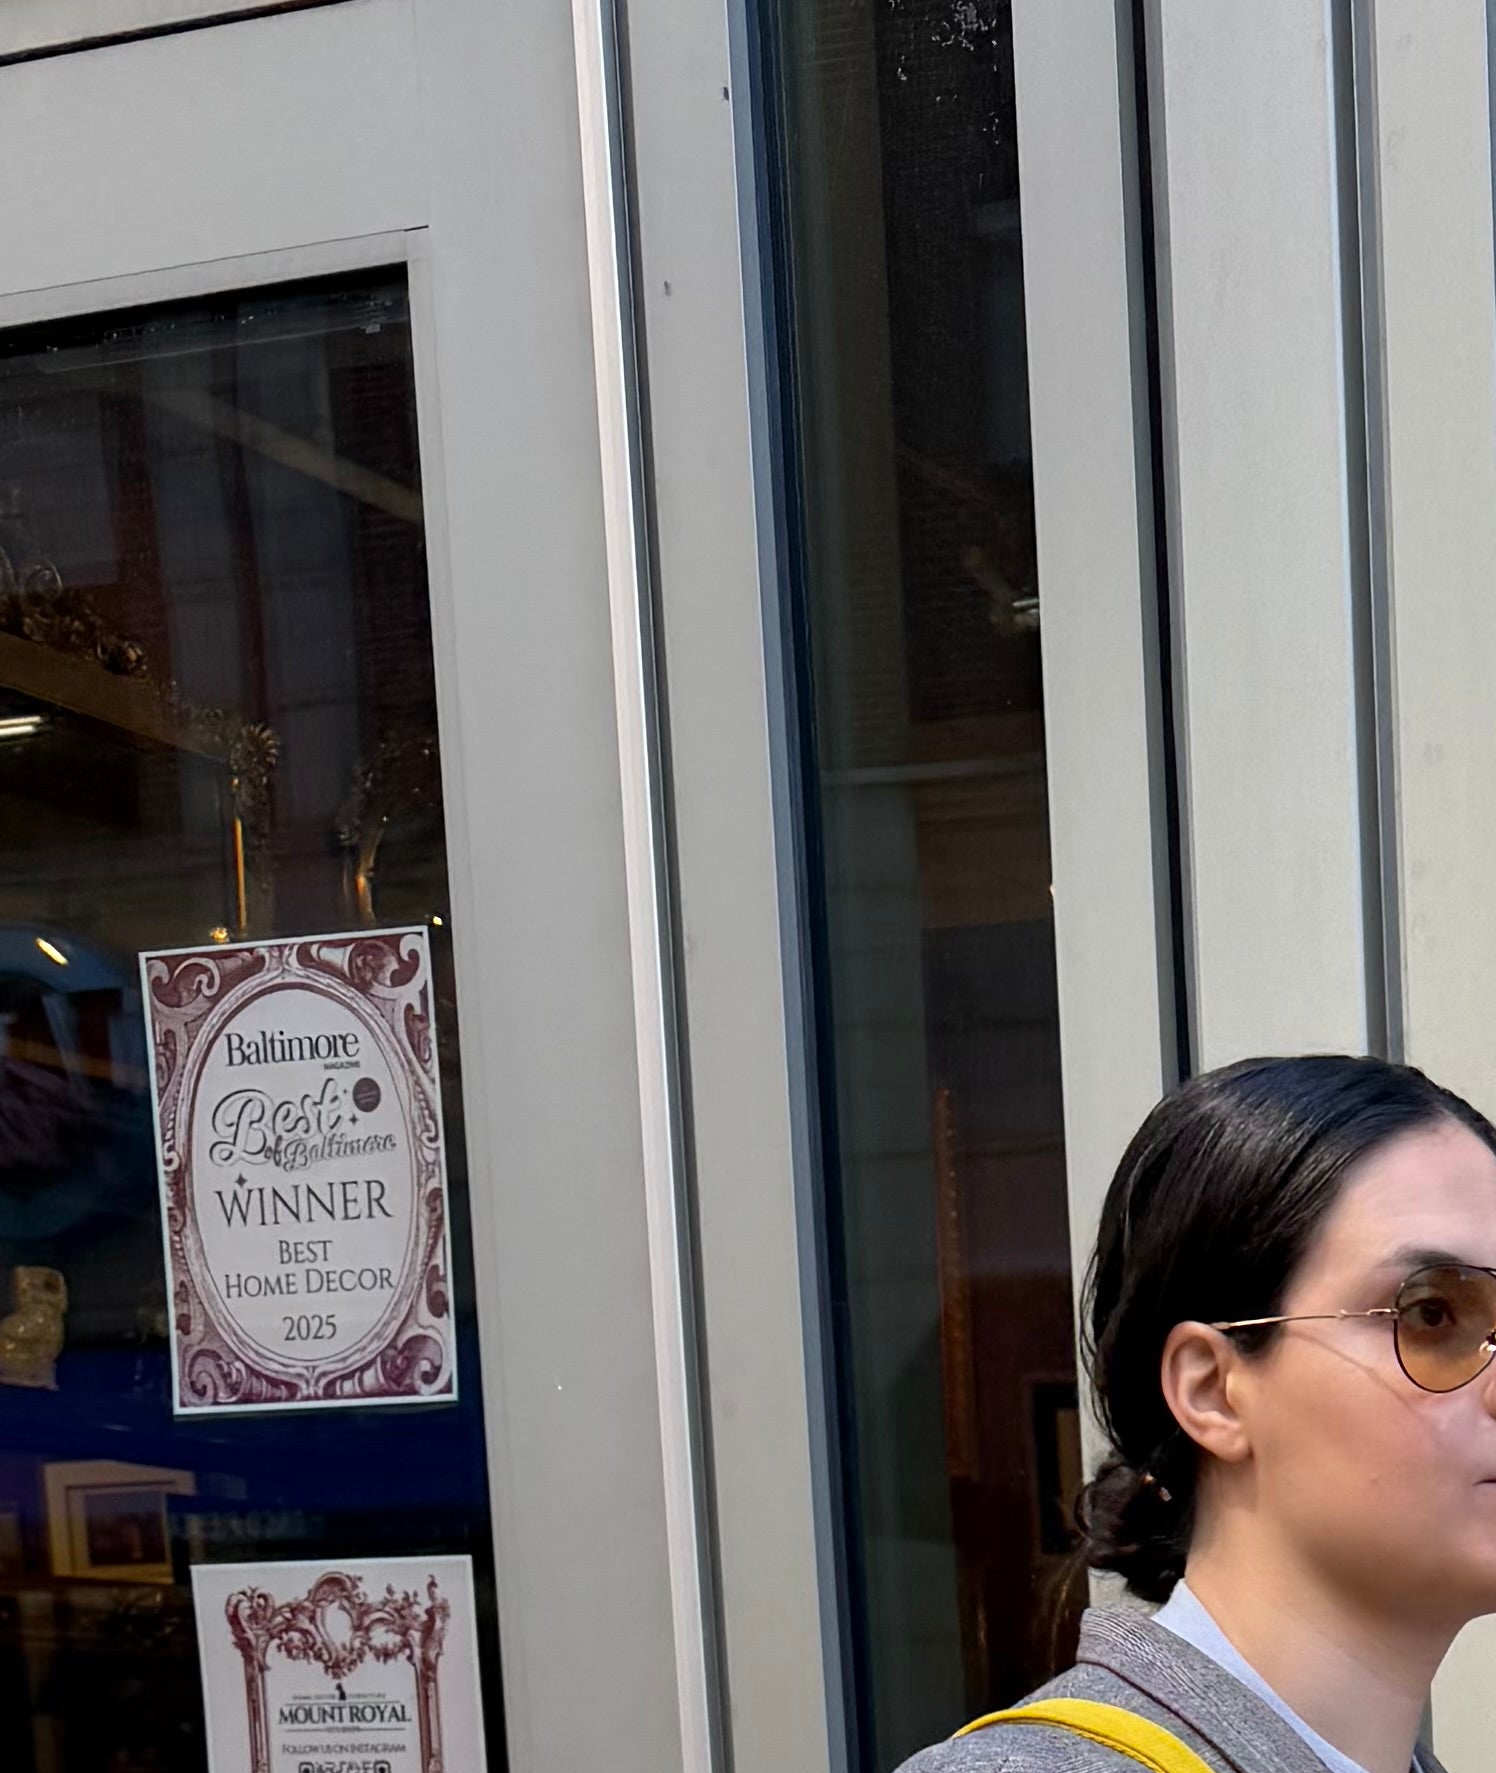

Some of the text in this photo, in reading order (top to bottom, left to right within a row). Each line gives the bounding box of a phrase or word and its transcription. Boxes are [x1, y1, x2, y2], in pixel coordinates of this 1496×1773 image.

[224, 1030, 361, 1067] Baltimore
[209, 1077, 342, 1167] Best
[264, 1133, 397, 1172] of Baltimore
[214, 1179, 396, 1228] WINNER
[278, 1239, 333, 1265] BEST
[224, 1267, 395, 1299] HOME DECOR
[282, 1314, 338, 1342] 2025
[278, 1703, 413, 1725] MOUNT ROYAL
